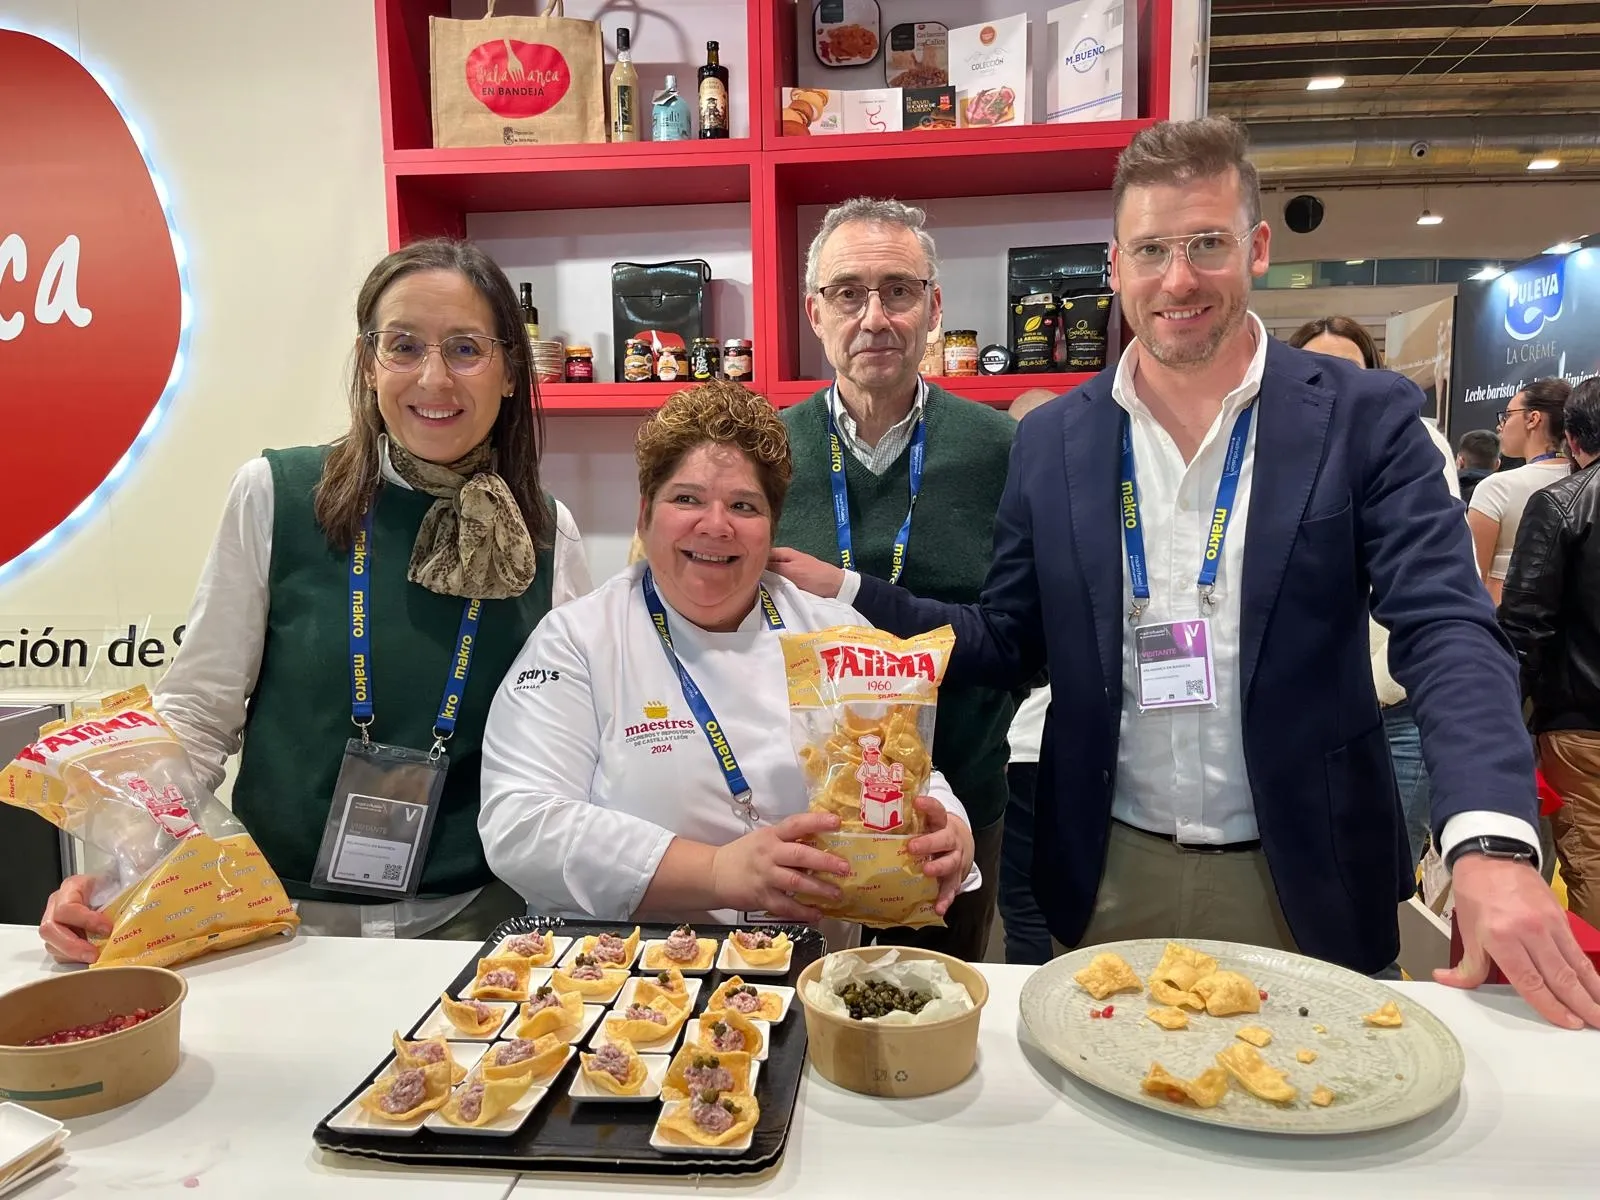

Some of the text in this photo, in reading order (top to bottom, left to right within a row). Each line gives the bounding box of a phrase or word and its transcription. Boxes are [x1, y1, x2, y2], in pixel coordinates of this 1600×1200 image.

[1065, 45, 1105, 66] M.BUENO
[482, 87, 545, 96] EN BANDEJA
[1508, 273, 1559, 307] PULEVA
[1507, 347, 1518, 364] LA
[1464, 386, 1486, 403] Leche
[1486, 381, 1515, 400] barista
[830, 433, 842, 473] makro
[1121, 480, 1138, 529] makro
[1206, 507, 1228, 561] makro
[352, 590, 366, 638] makro
[1187, 623, 1200, 637] V
[108, 625, 165, 667] de
[454, 634, 472, 680] makro
[354, 654, 368, 701] makro
[517, 669, 560, 684] gary's
[867, 681, 891, 691] 1960
[441, 694, 459, 718] kro
[625, 720, 694, 737] maestres
[90, 735, 118, 747] 1960
[651, 744, 672, 754] 2024
[706, 720, 736, 771] makro
[405, 808, 418, 822] V
[183, 880, 213, 895] Snacks
[216, 887, 244, 901] Snacks
[247, 895, 273, 909] Snacks
[277, 906, 294, 916] Snac
[113, 927, 143, 945] Snacks
[146, 932, 176, 949] Snacks
